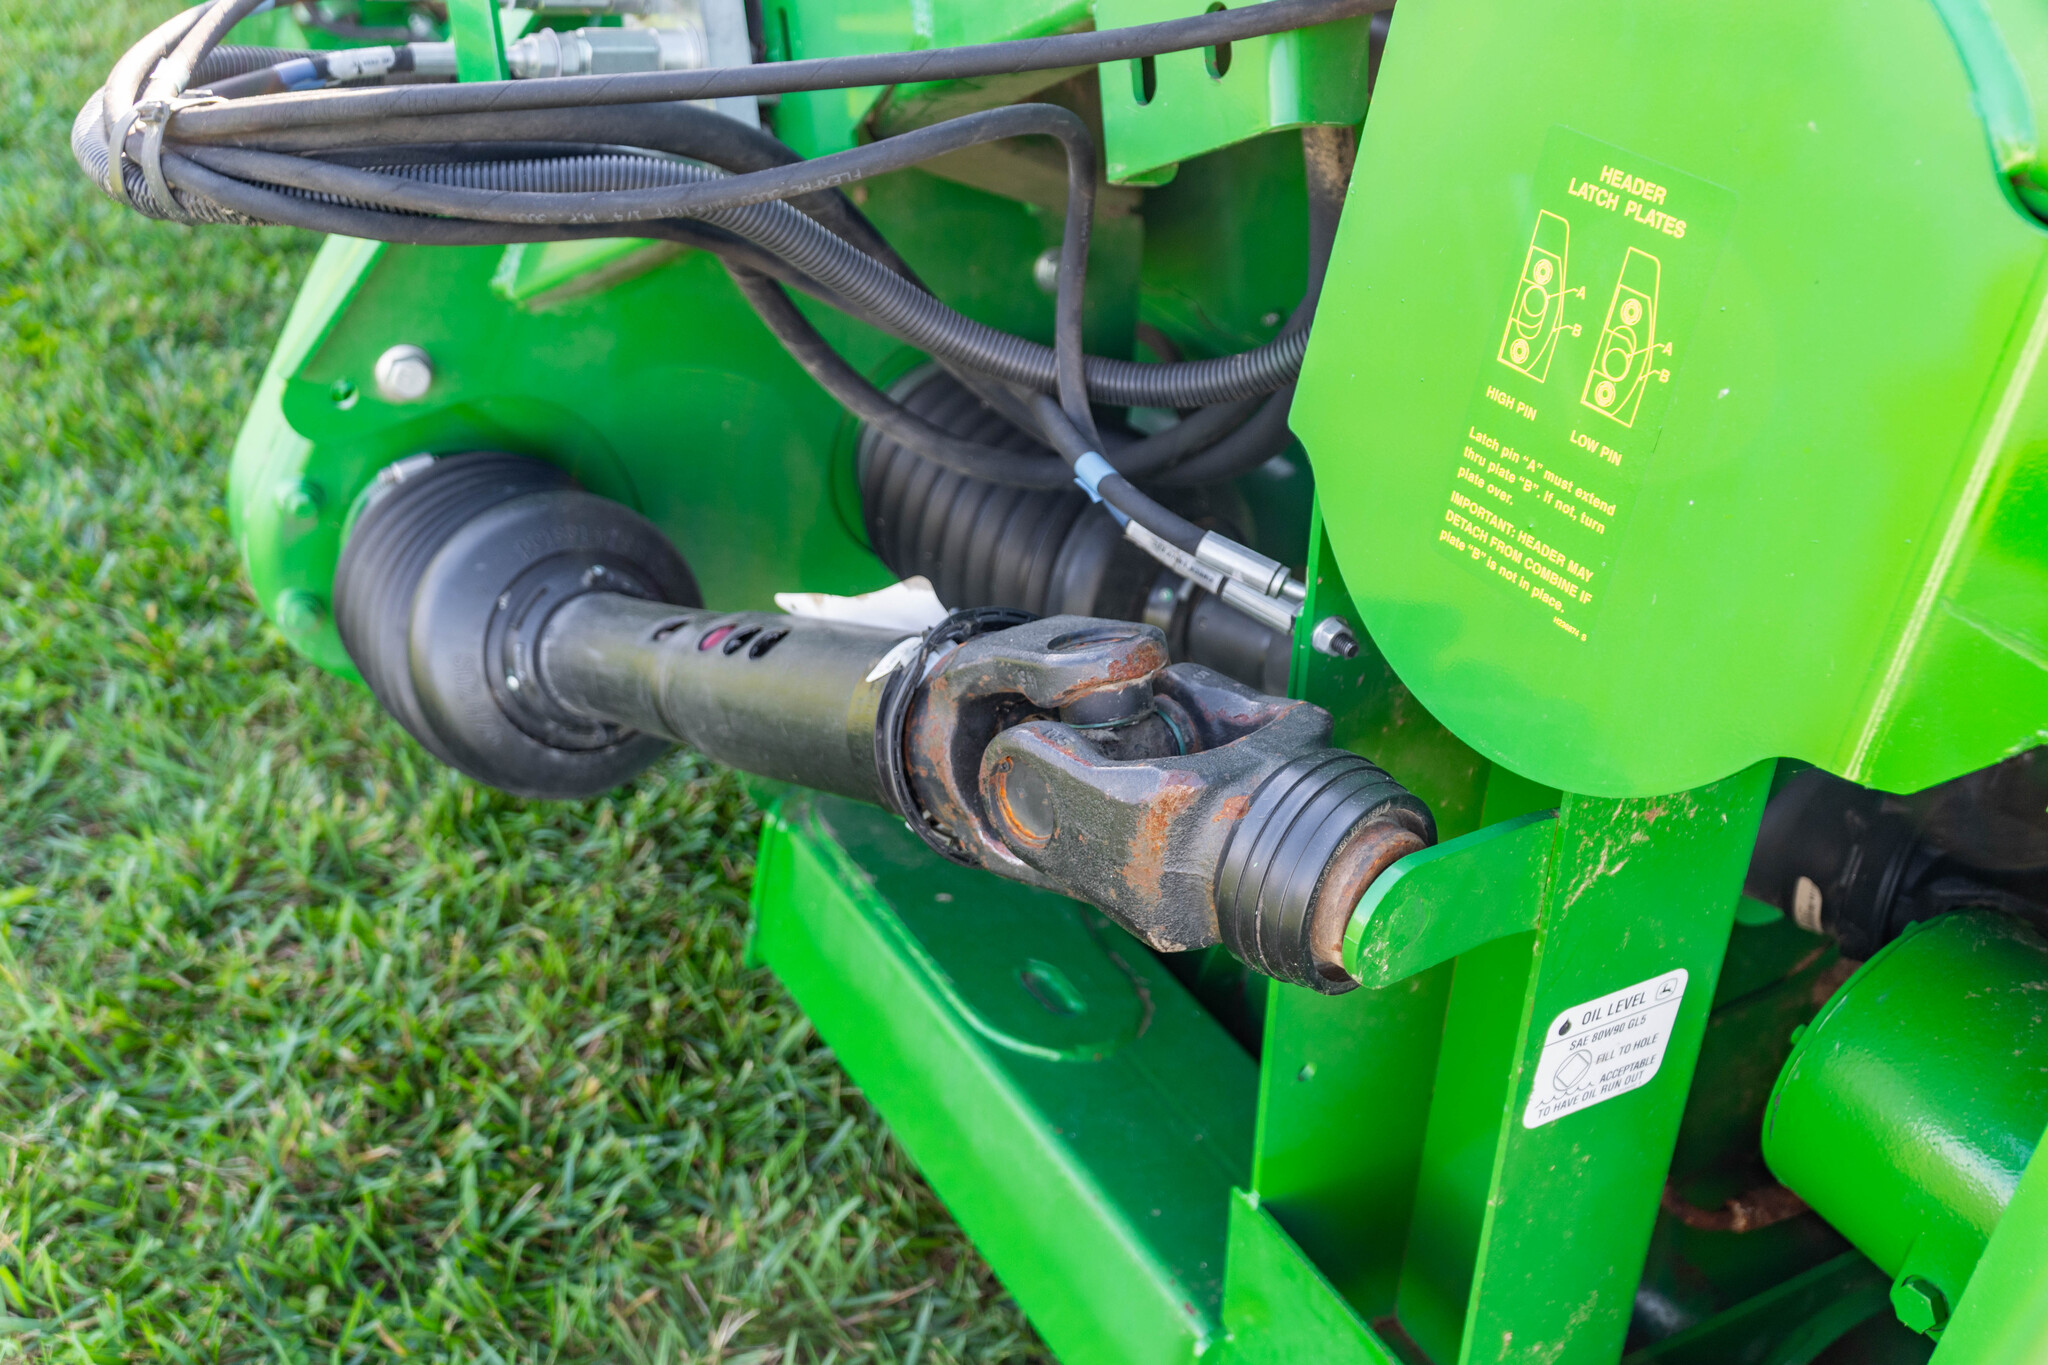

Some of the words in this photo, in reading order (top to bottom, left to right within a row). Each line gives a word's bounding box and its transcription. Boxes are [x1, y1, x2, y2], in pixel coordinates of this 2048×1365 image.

[1600, 165, 1667, 205] HEADER
[1568, 177, 1620, 212] LATCH
[1624, 200, 1687, 238] PLATES
[1576, 286, 1586, 300] A
[1571, 323, 1582, 337] B
[1662, 342, 1672, 356] A
[1659, 368, 1670, 383] B
[1486, 385, 1516, 409] HIGH
[1516, 402, 1537, 421] PIN
[1570, 430, 1599, 453] LOW
[1600, 446, 1622, 466] PIN
[1457, 467, 1485, 488] plate
[1486, 484, 1513, 506] over.
[1468, 426, 1499, 452] Latch
[1500, 447, 1520, 463] pin
[1543, 470, 1574, 493] must
[1575, 487, 1616, 517] extend
[1463, 446, 1486, 467] thru
[1487, 461, 1516, 484] plate
[1543, 490, 1554, 504] If
[1554, 499, 1577, 520] not,
[1580, 512, 1605, 534] turn
[1450, 490, 1516, 538] IMPORTANT:
[1517, 530, 1566, 567] HEADER
[1567, 560, 1594, 582] MAY
[1439, 530, 1465, 551] plate
[1486, 556, 1497, 570] is
[1498, 566, 1517, 583] not
[1518, 576, 1530, 591] in
[1531, 586, 1564, 613] place.
[1445, 509, 1488, 543] DETACH
[1489, 536, 1523, 564] FROM
[1524, 558, 1578, 598] COMBINE
[1579, 590, 1592, 604] IF
[1582, 1008, 1602, 1025] OIL
[1608, 992, 1646, 1015] LEVEL
[1570, 1037, 1589, 1050] SAE
[1592, 1025, 1625, 1042] 80W90
[1628, 1015, 1646, 1029] GL5
[1596, 1050, 1615, 1064] FILL
[1619, 1044, 1632, 1055] TO
[1633, 1033, 1659, 1050] HOLE
[1600, 1055, 1657, 1083] ACCEPTABLE
[1538, 1107, 1550, 1118] TO
[1554, 1095, 1579, 1112] HAVE
[1582, 1089, 1597, 1102] OIL
[1601, 1080, 1621, 1094] RUN
[1624, 1071, 1644, 1085] OUT
